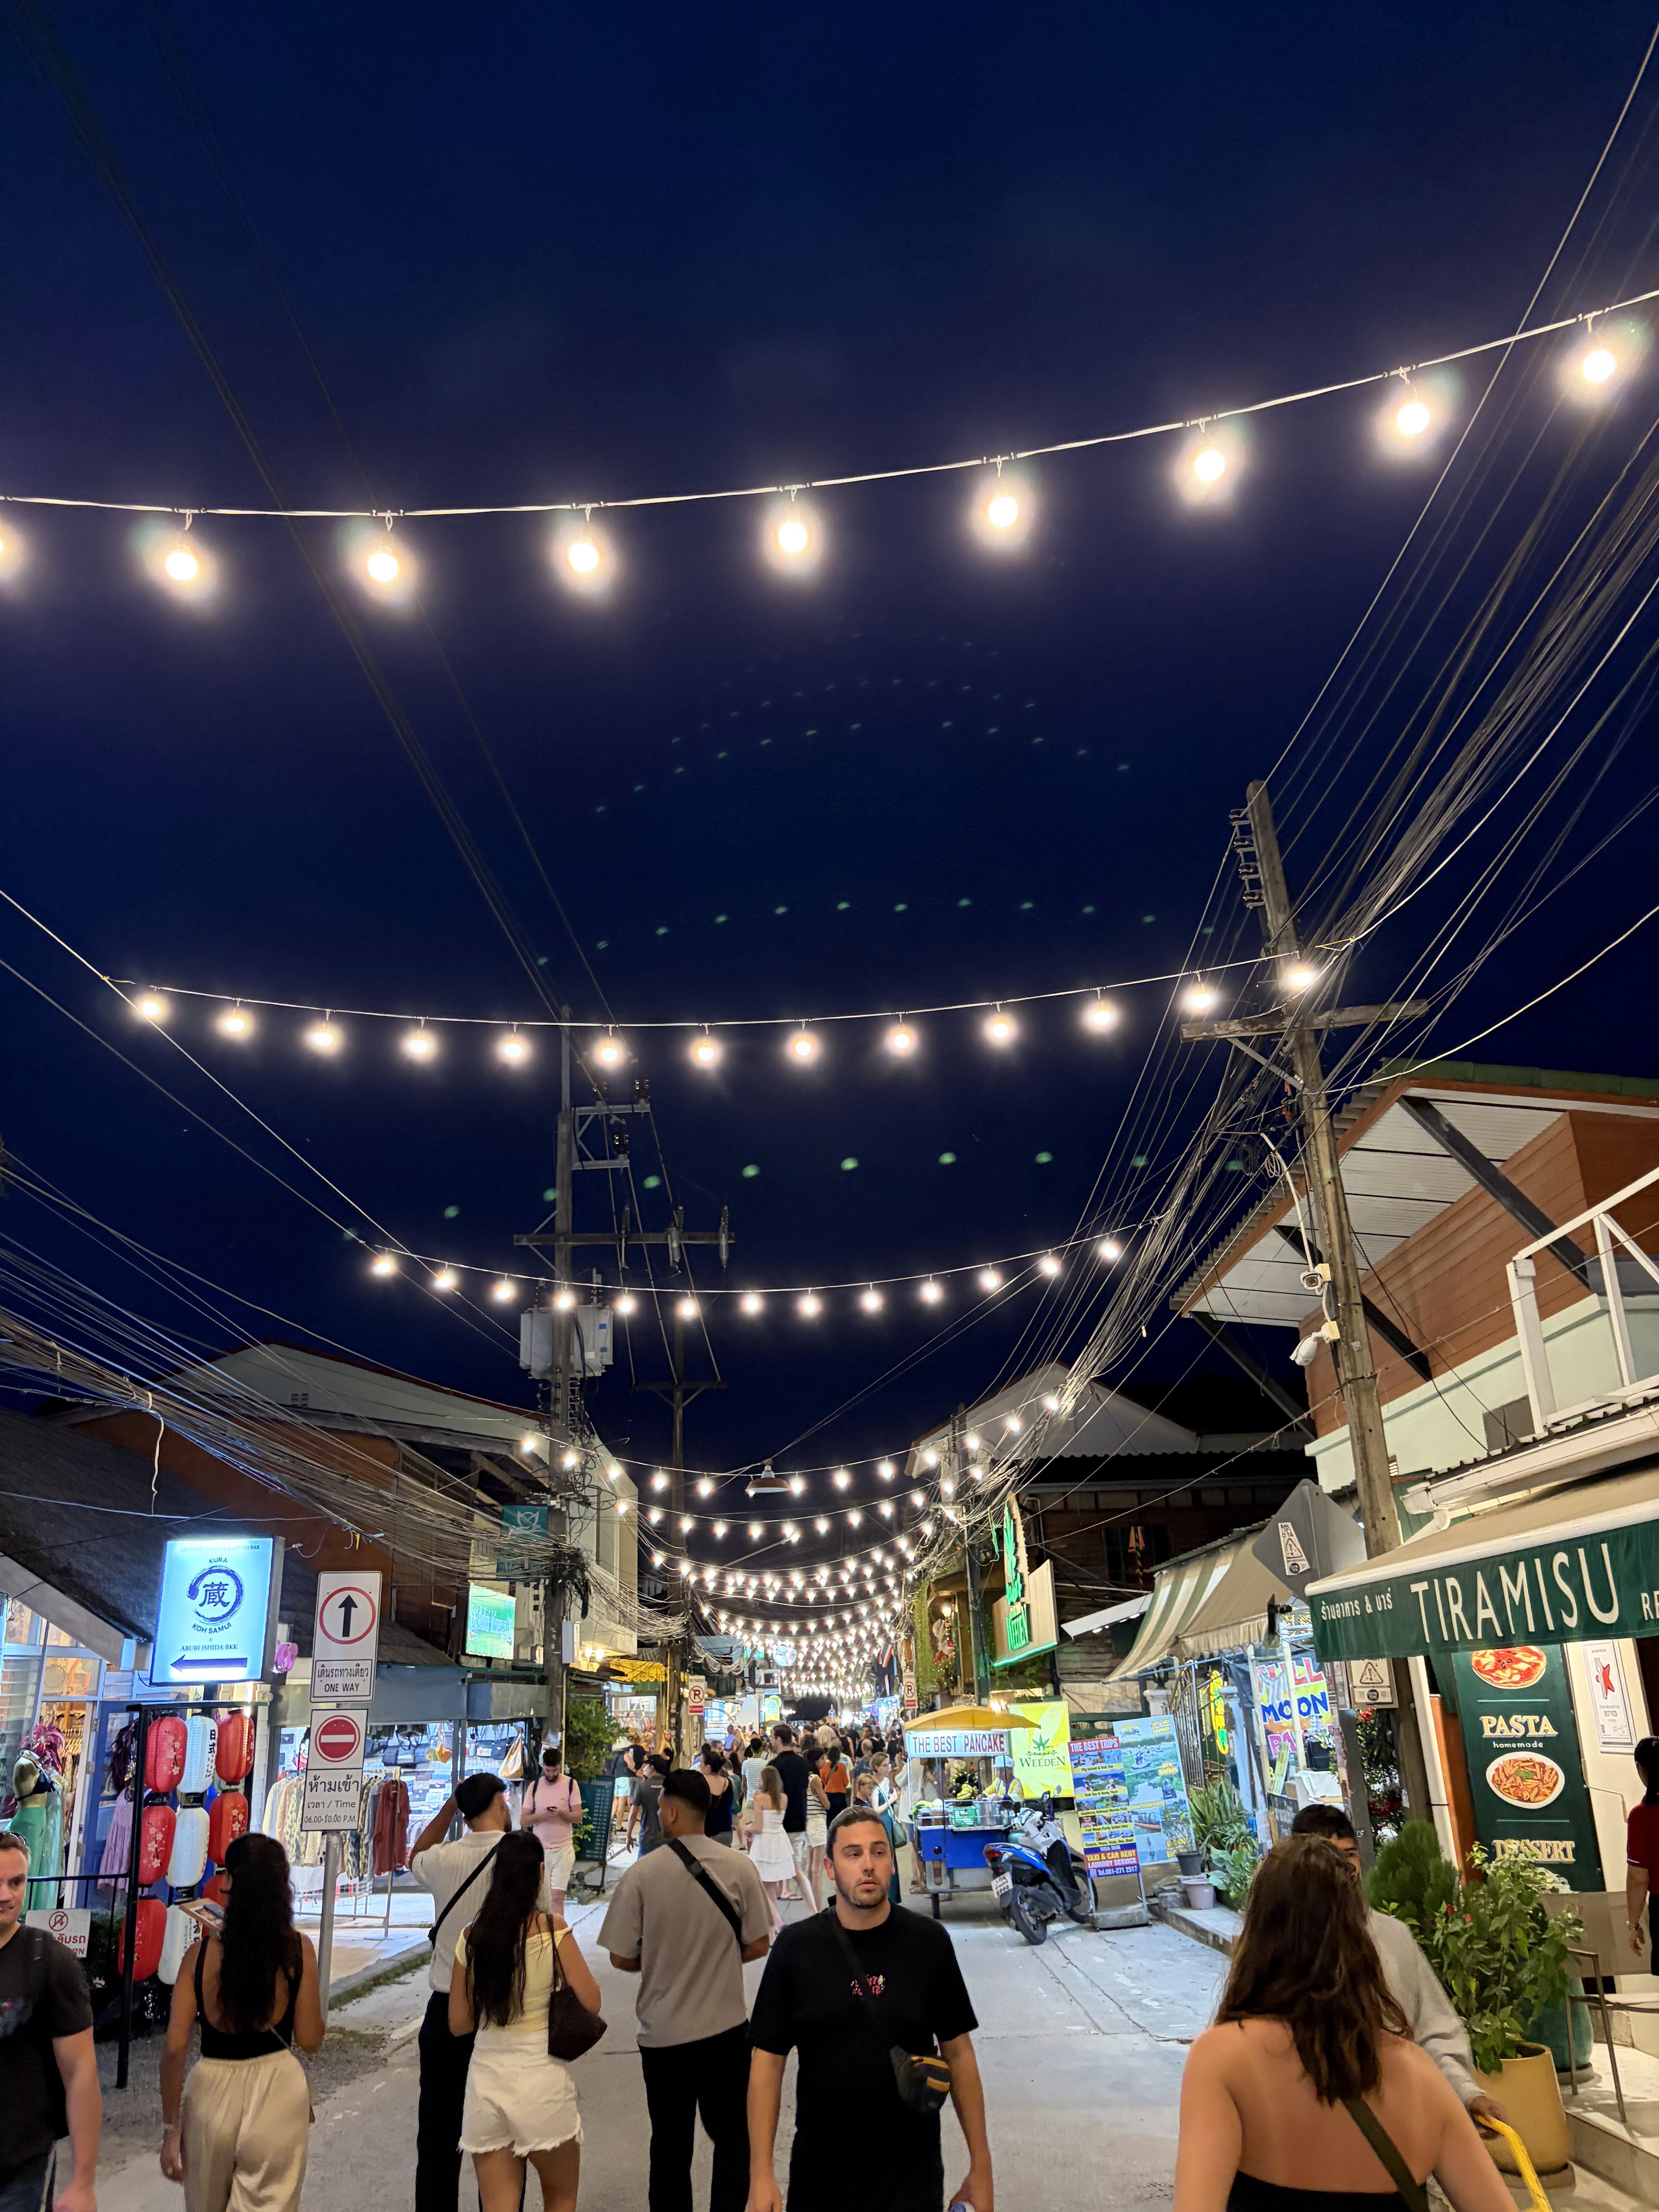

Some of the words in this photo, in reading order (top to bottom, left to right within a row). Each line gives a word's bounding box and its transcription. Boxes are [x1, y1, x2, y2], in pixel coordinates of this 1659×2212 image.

[1410, 1543, 1619, 1643] TIRAMISU
[1365, 1595, 1373, 1613] &
[192, 1623, 207, 1633] KOH
[208, 1622, 232, 1634] SAMUI
[318, 1663, 369, 1678] เดินรถทางเดียว
[325, 1683, 339, 1692] ONE
[342, 1683, 360, 1692] WAY
[1261, 1691, 1329, 1723] MOON
[1479, 1715, 1559, 1738] PASTA
[913, 1737, 931, 1753] THE
[934, 1736, 957, 1753] BEST
[964, 1734, 1005, 1753] PANCAKE
[1070, 1742, 1083, 1752] THE
[1083, 1740, 1099, 1751] BEST
[1099, 1738, 1118, 1749] TRIPS
[1019, 1756, 1065, 1767] WEEDEN
[309, 1774, 359, 1792] ห้ามเข้า
[1086, 1853, 1100, 1862] TAXI
[1120, 1850, 1136, 1858] RENT
